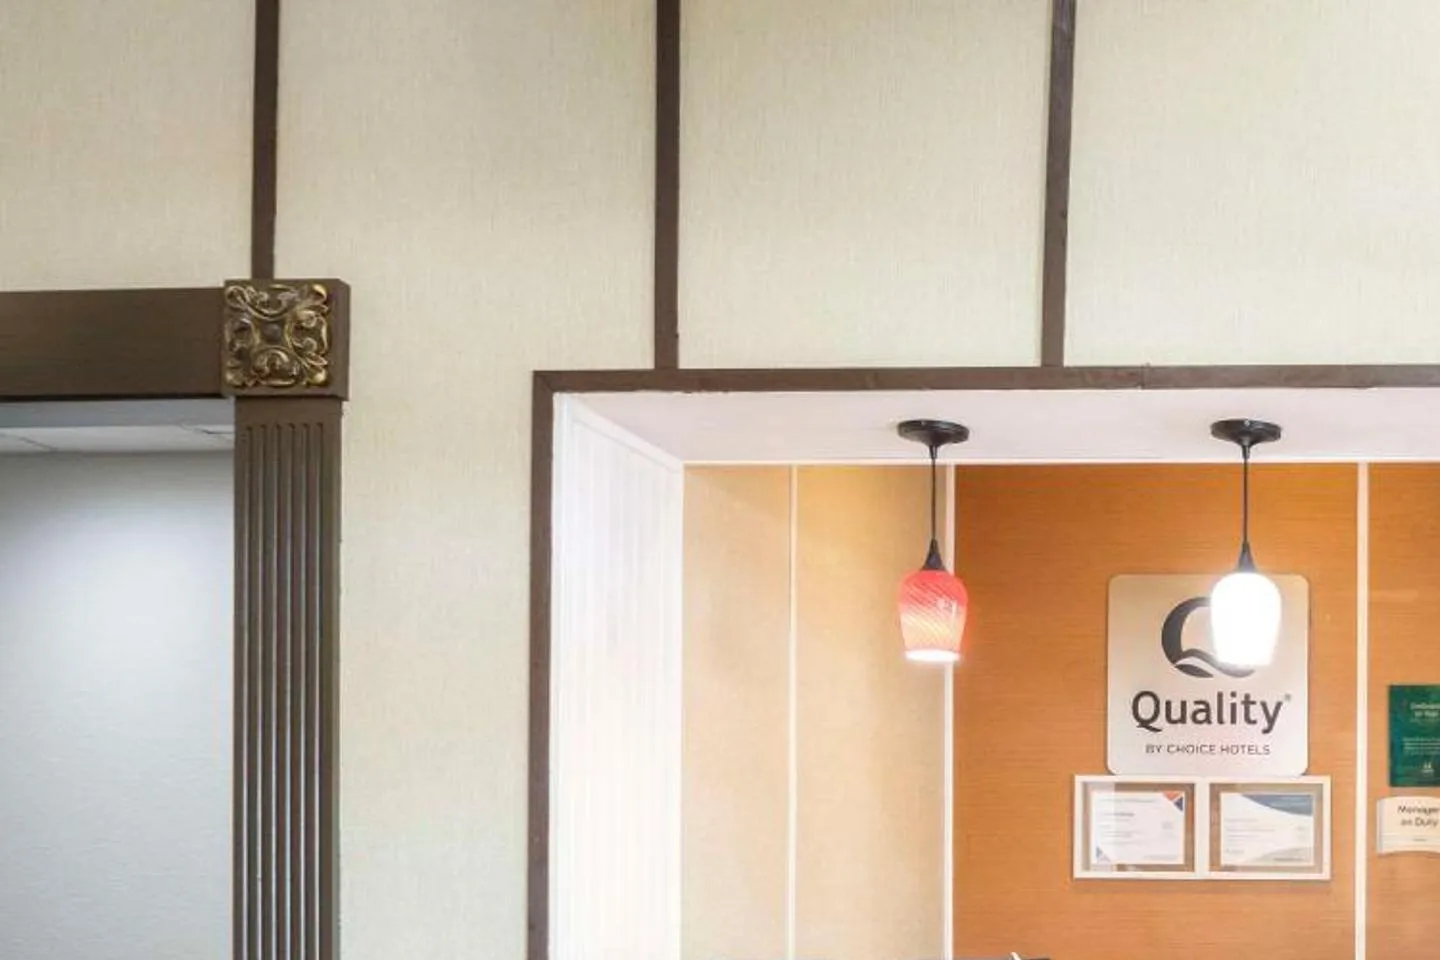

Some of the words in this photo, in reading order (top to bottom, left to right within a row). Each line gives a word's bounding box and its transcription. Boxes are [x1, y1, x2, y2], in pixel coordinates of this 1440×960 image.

[1131, 690, 1283, 735] Quality
[1145, 744, 1162, 755] BY
[1167, 744, 1216, 755] CHOICE
[1220, 745, 1271, 756] HOTELS
[1397, 805, 1440, 816] Manager
[1415, 817, 1439, 828] Duty
